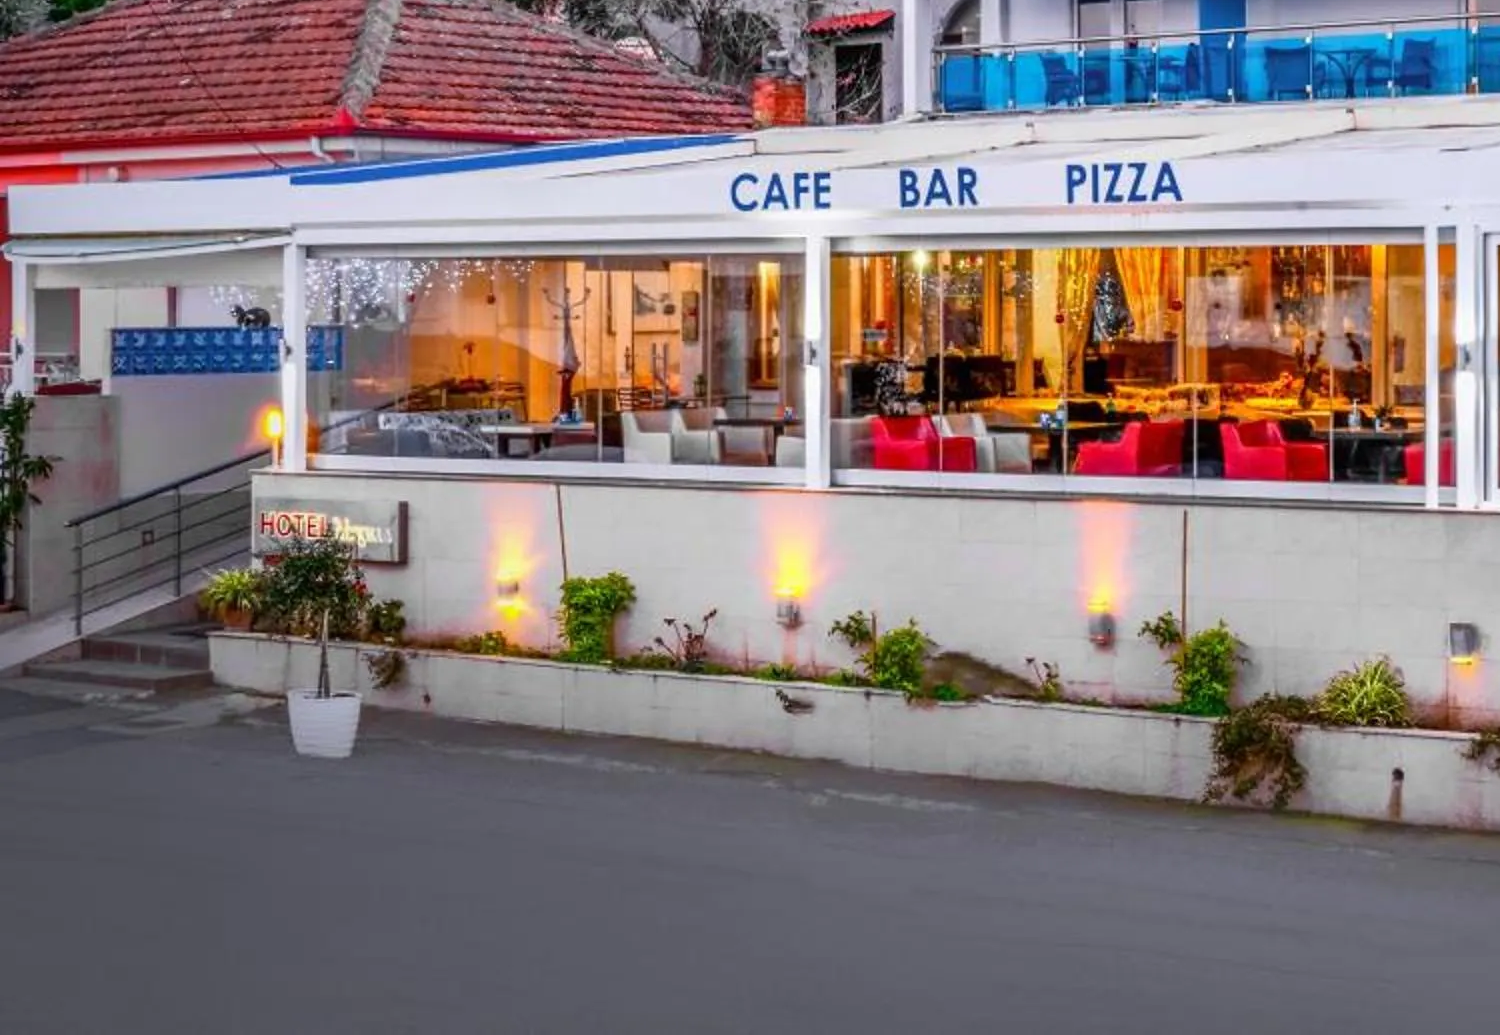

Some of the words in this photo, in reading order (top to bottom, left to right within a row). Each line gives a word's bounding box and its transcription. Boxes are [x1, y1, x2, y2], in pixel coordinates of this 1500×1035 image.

[731, 172, 832, 212] CAFE
[900, 167, 979, 209] BAR
[1066, 161, 1184, 204] PIZZA
[260, 512, 331, 538] HOTEL
